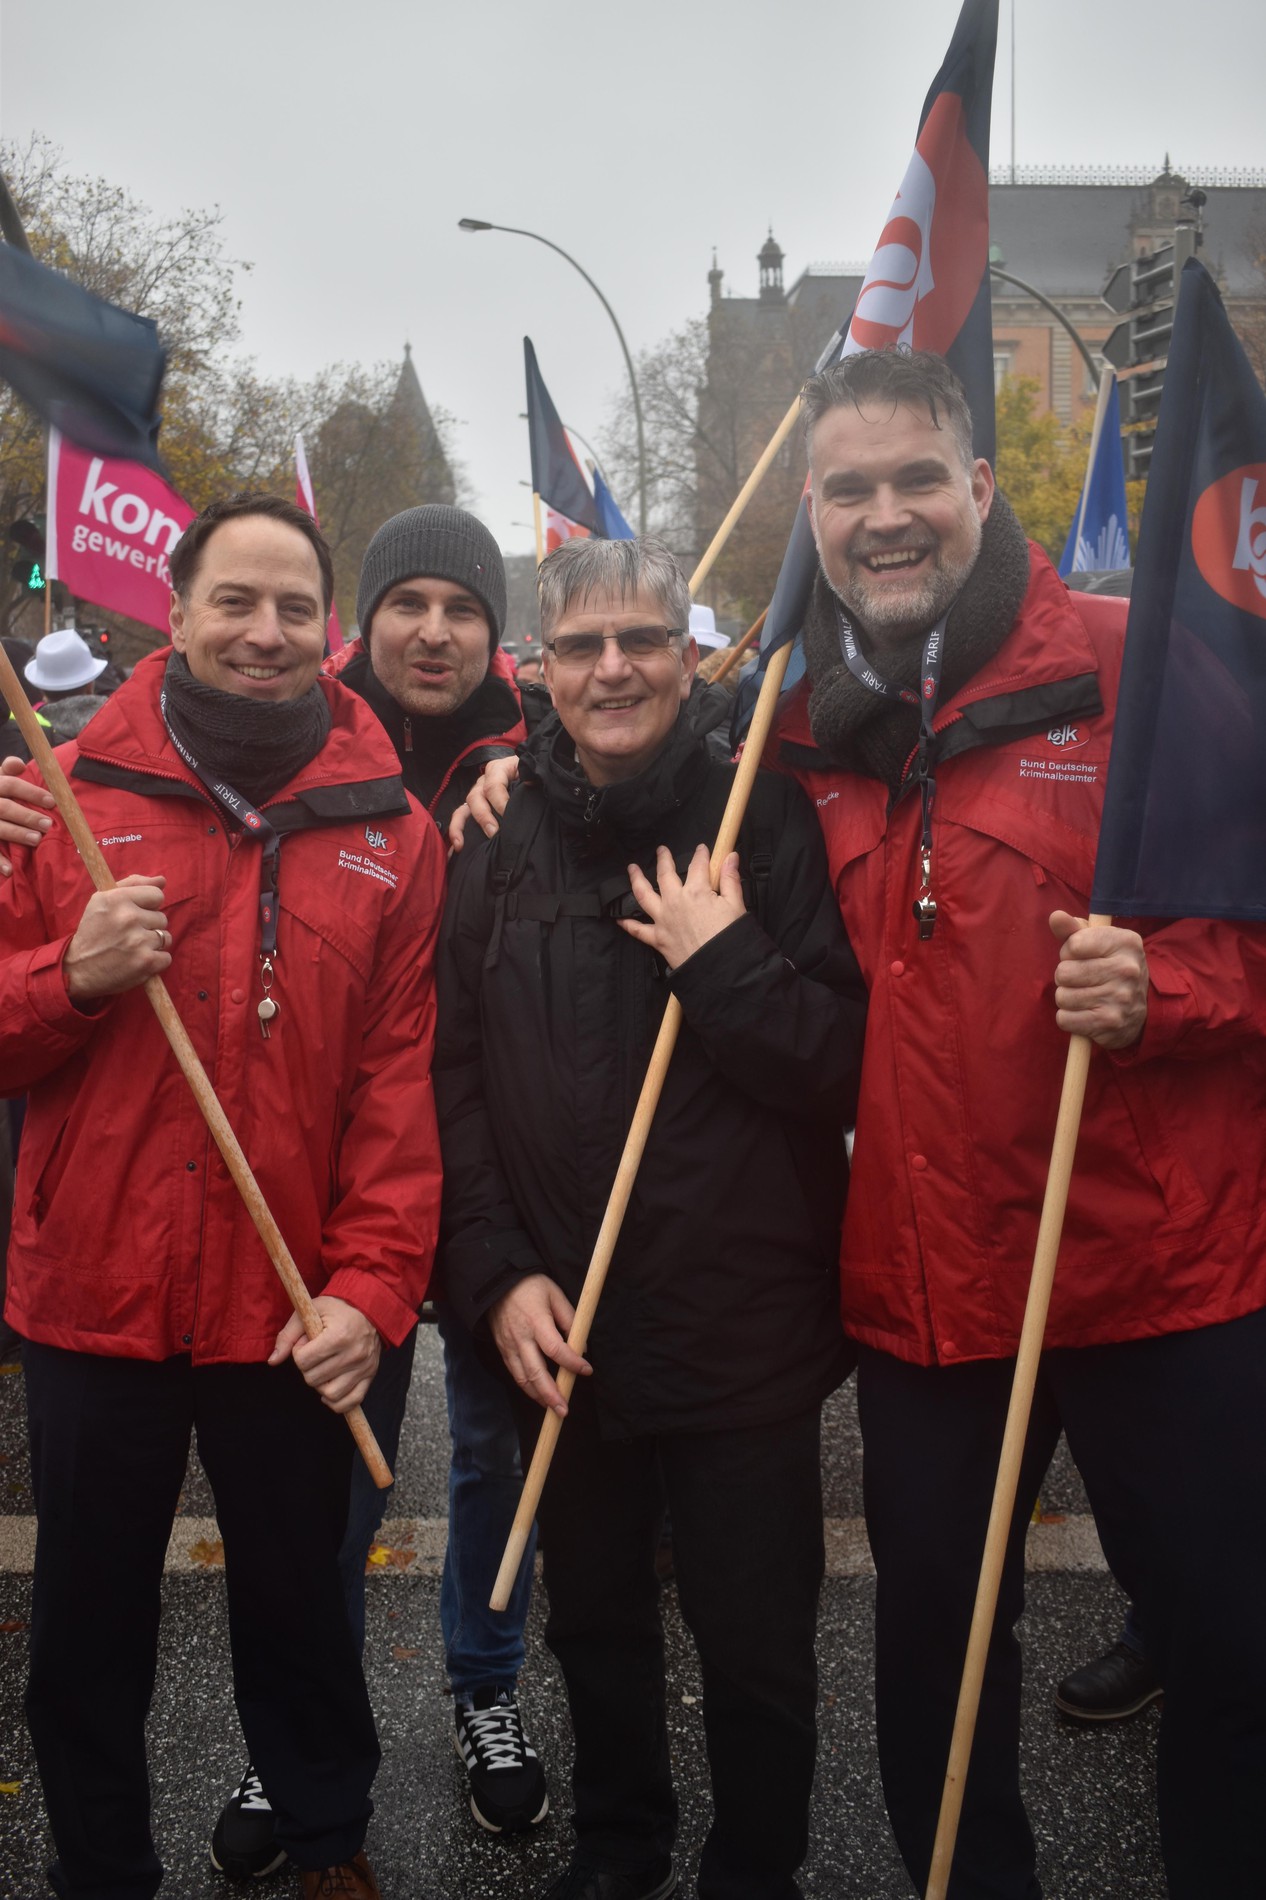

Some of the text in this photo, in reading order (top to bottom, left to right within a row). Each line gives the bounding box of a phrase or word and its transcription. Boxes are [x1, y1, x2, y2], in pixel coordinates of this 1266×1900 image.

[71, 524, 174, 589] gewerk
[927, 631, 940, 665] TARIF
[861, 670, 887, 695] TARIF
[1019, 769, 1097, 783] Kriminalbeamter
[1020, 759, 1098, 772] Bund Deutscher
[213, 783, 241, 810] TARIF
[101, 833, 142, 846] Schwabe
[339, 850, 399, 882] Bund Deutscher
